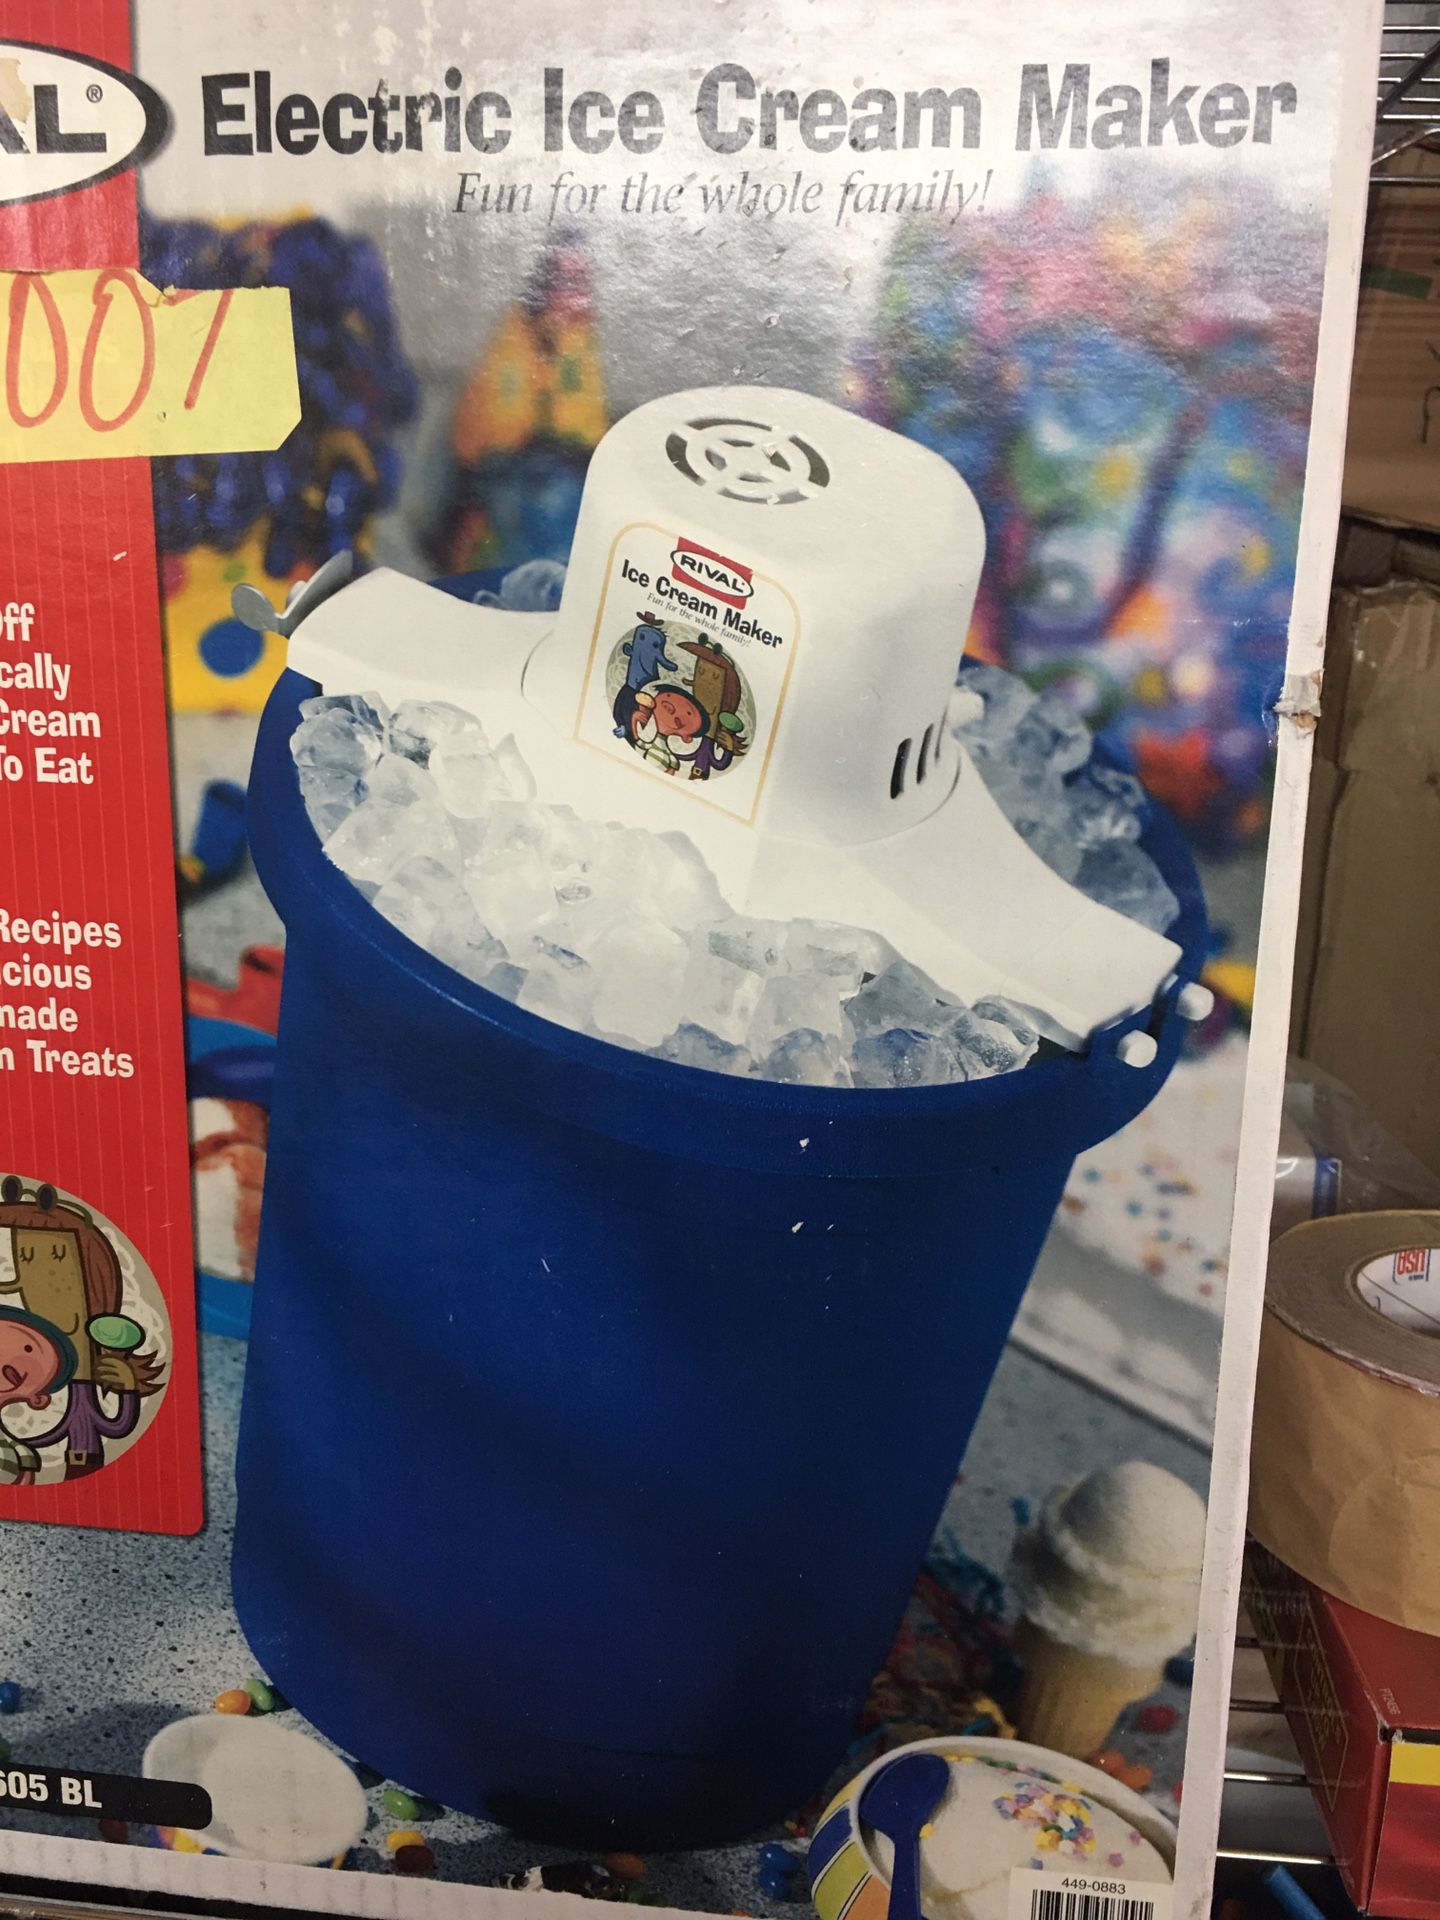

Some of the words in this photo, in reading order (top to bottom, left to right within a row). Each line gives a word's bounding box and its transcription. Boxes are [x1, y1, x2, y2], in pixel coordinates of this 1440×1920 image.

[201, 66, 512, 156] Electric
[544, 67, 665, 155] Ice
[696, 62, 982, 154] Cream
[1014, 57, 1298, 151] Maker
[452, 172, 532, 214] Fun
[547, 171, 606, 224] for
[620, 172, 684, 214] the
[701, 170, 825, 216] whole
[835, 168, 994, 226] family!
[679, 554, 745, 594] RIVAL
[0, 601, 35, 642] ff
[621, 558, 650, 588] Ice
[656, 576, 718, 620] Cream
[723, 608, 783, 649] Maker
[646, 592, 664, 607] Fun
[665, 601, 678, 612] for
[680, 607, 694, 620] the
[694, 616, 720, 632] whole
[720, 627, 752, 648] family!
[34, 747, 94, 785] Eat
[26, 1038, 135, 1078] Treats
[60, 1776, 103, 1808] BL
[1061, 1877, 1126, 1895] 449-0883
